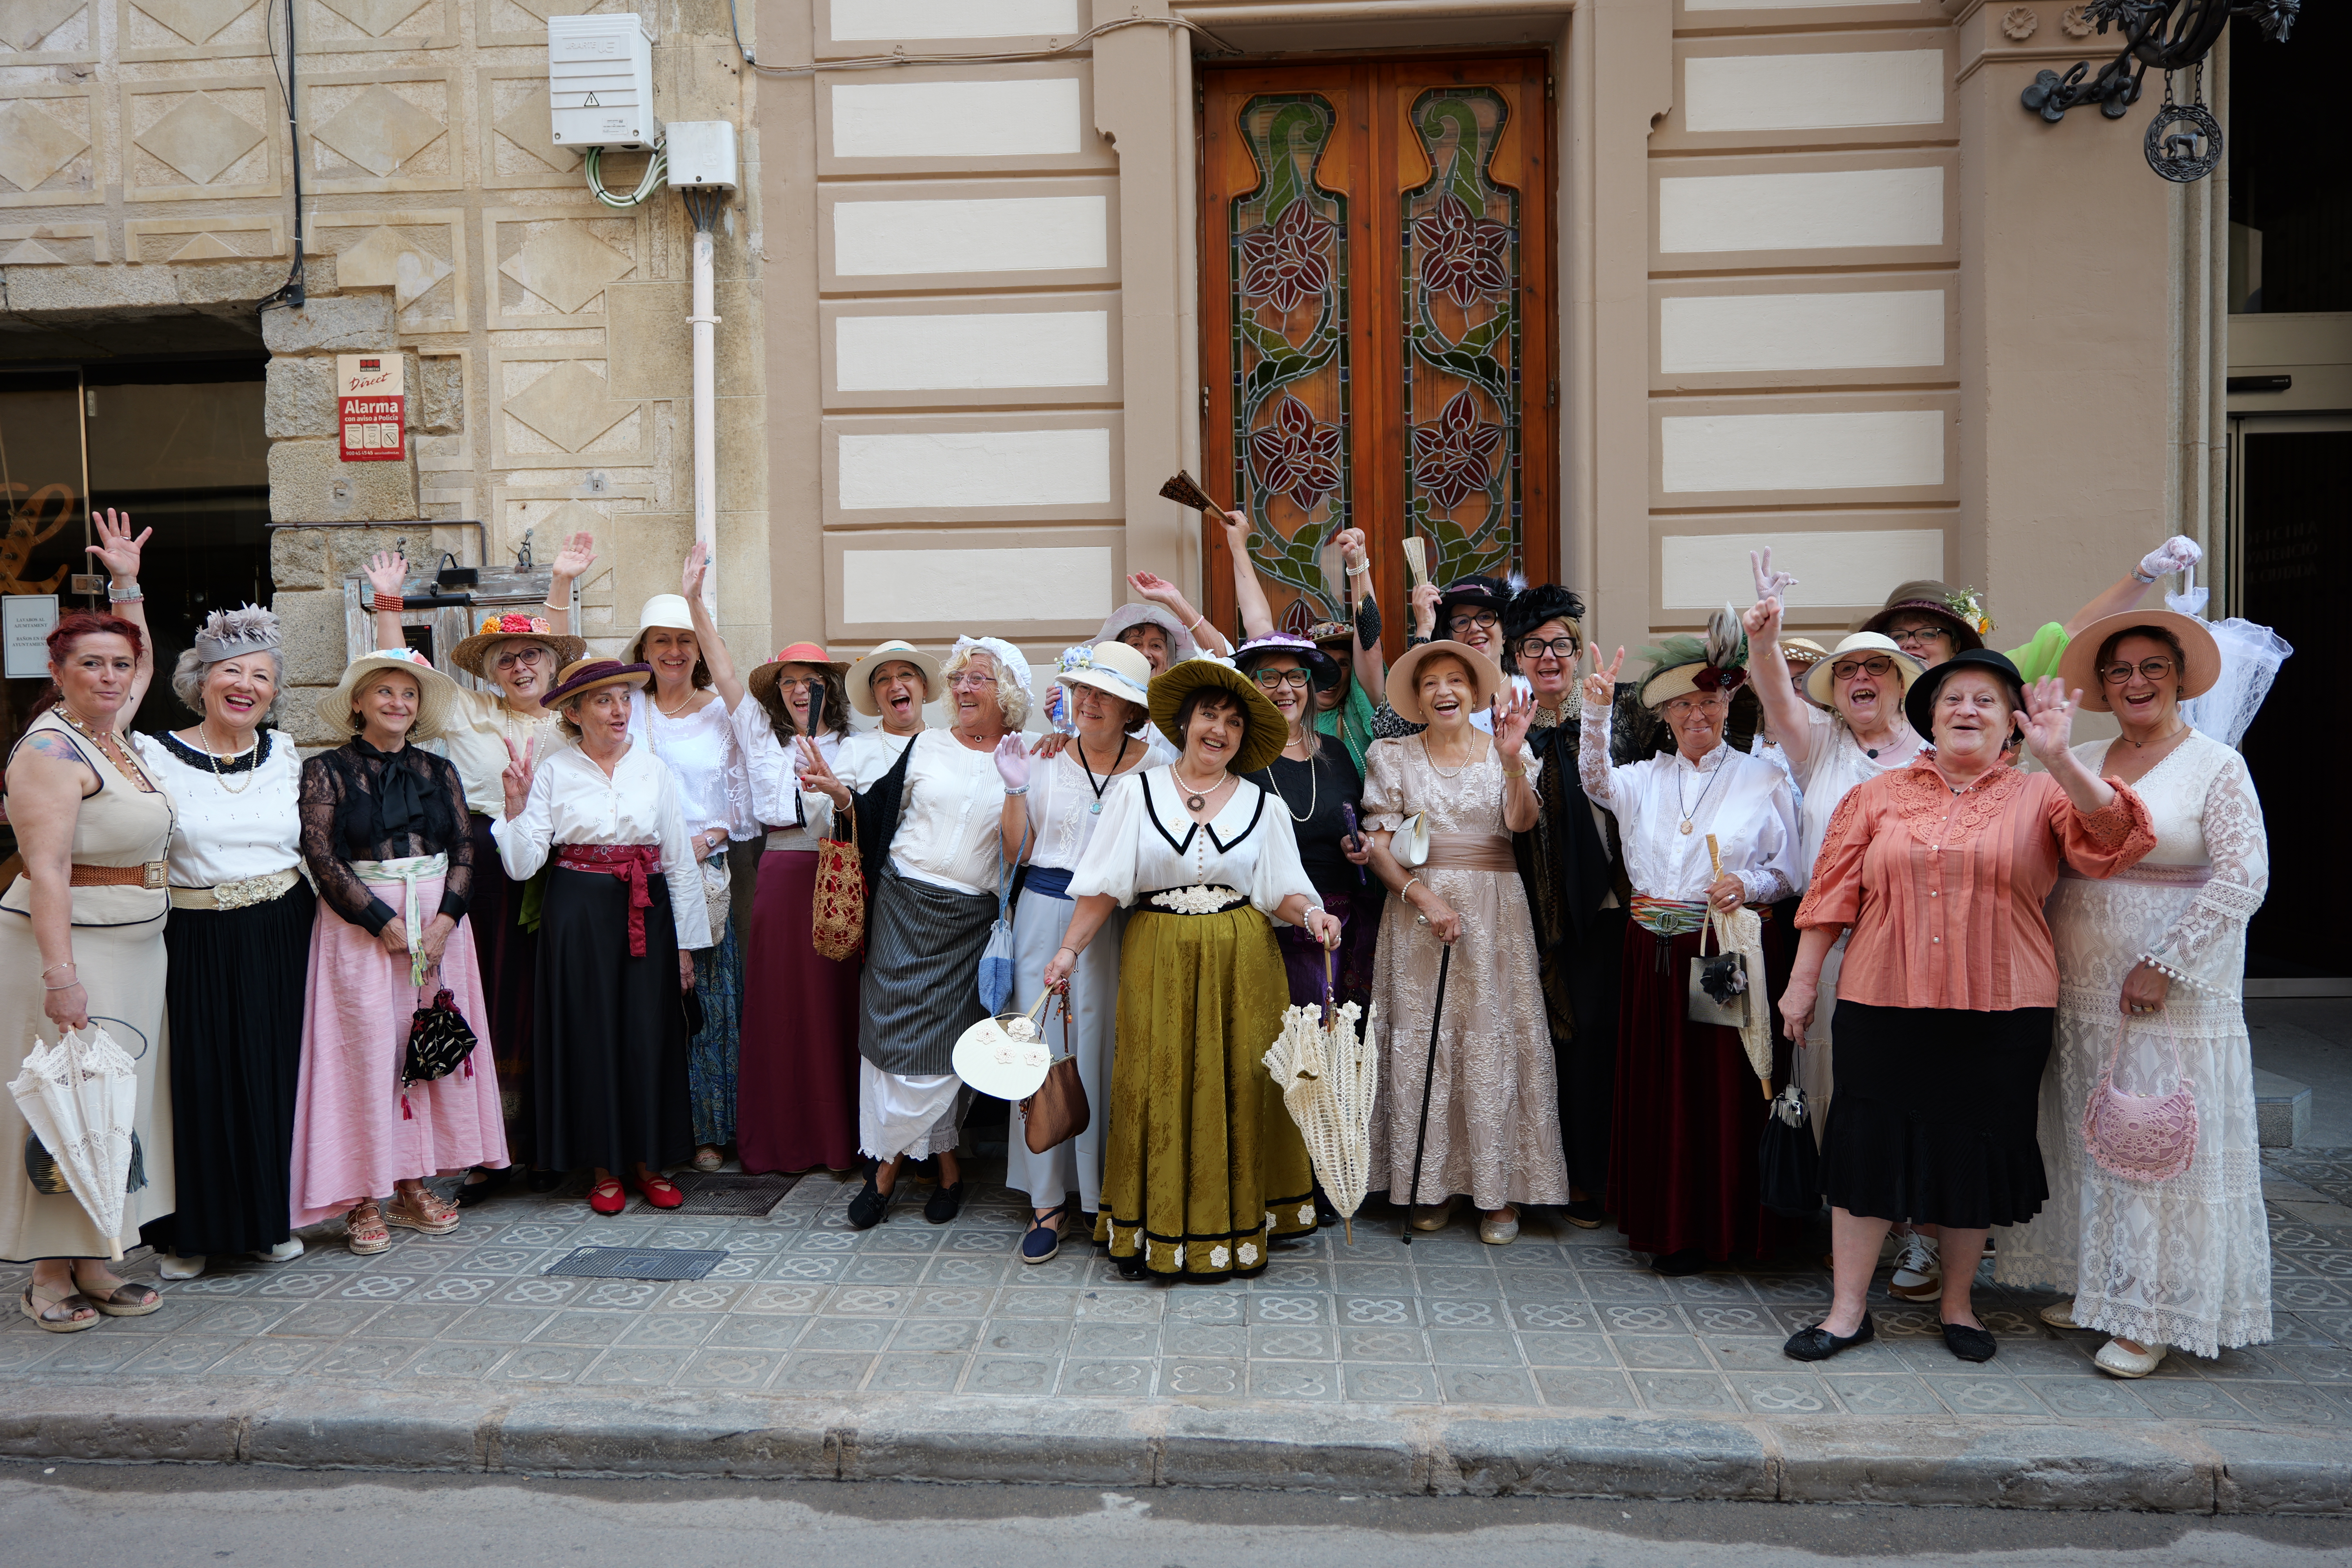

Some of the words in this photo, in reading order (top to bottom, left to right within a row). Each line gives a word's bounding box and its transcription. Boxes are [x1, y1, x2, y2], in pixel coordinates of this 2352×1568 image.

[566, 41, 596, 49] URIARTE
[349, 372, 393, 391] Direct
[345, 399, 398, 414] Alarma
